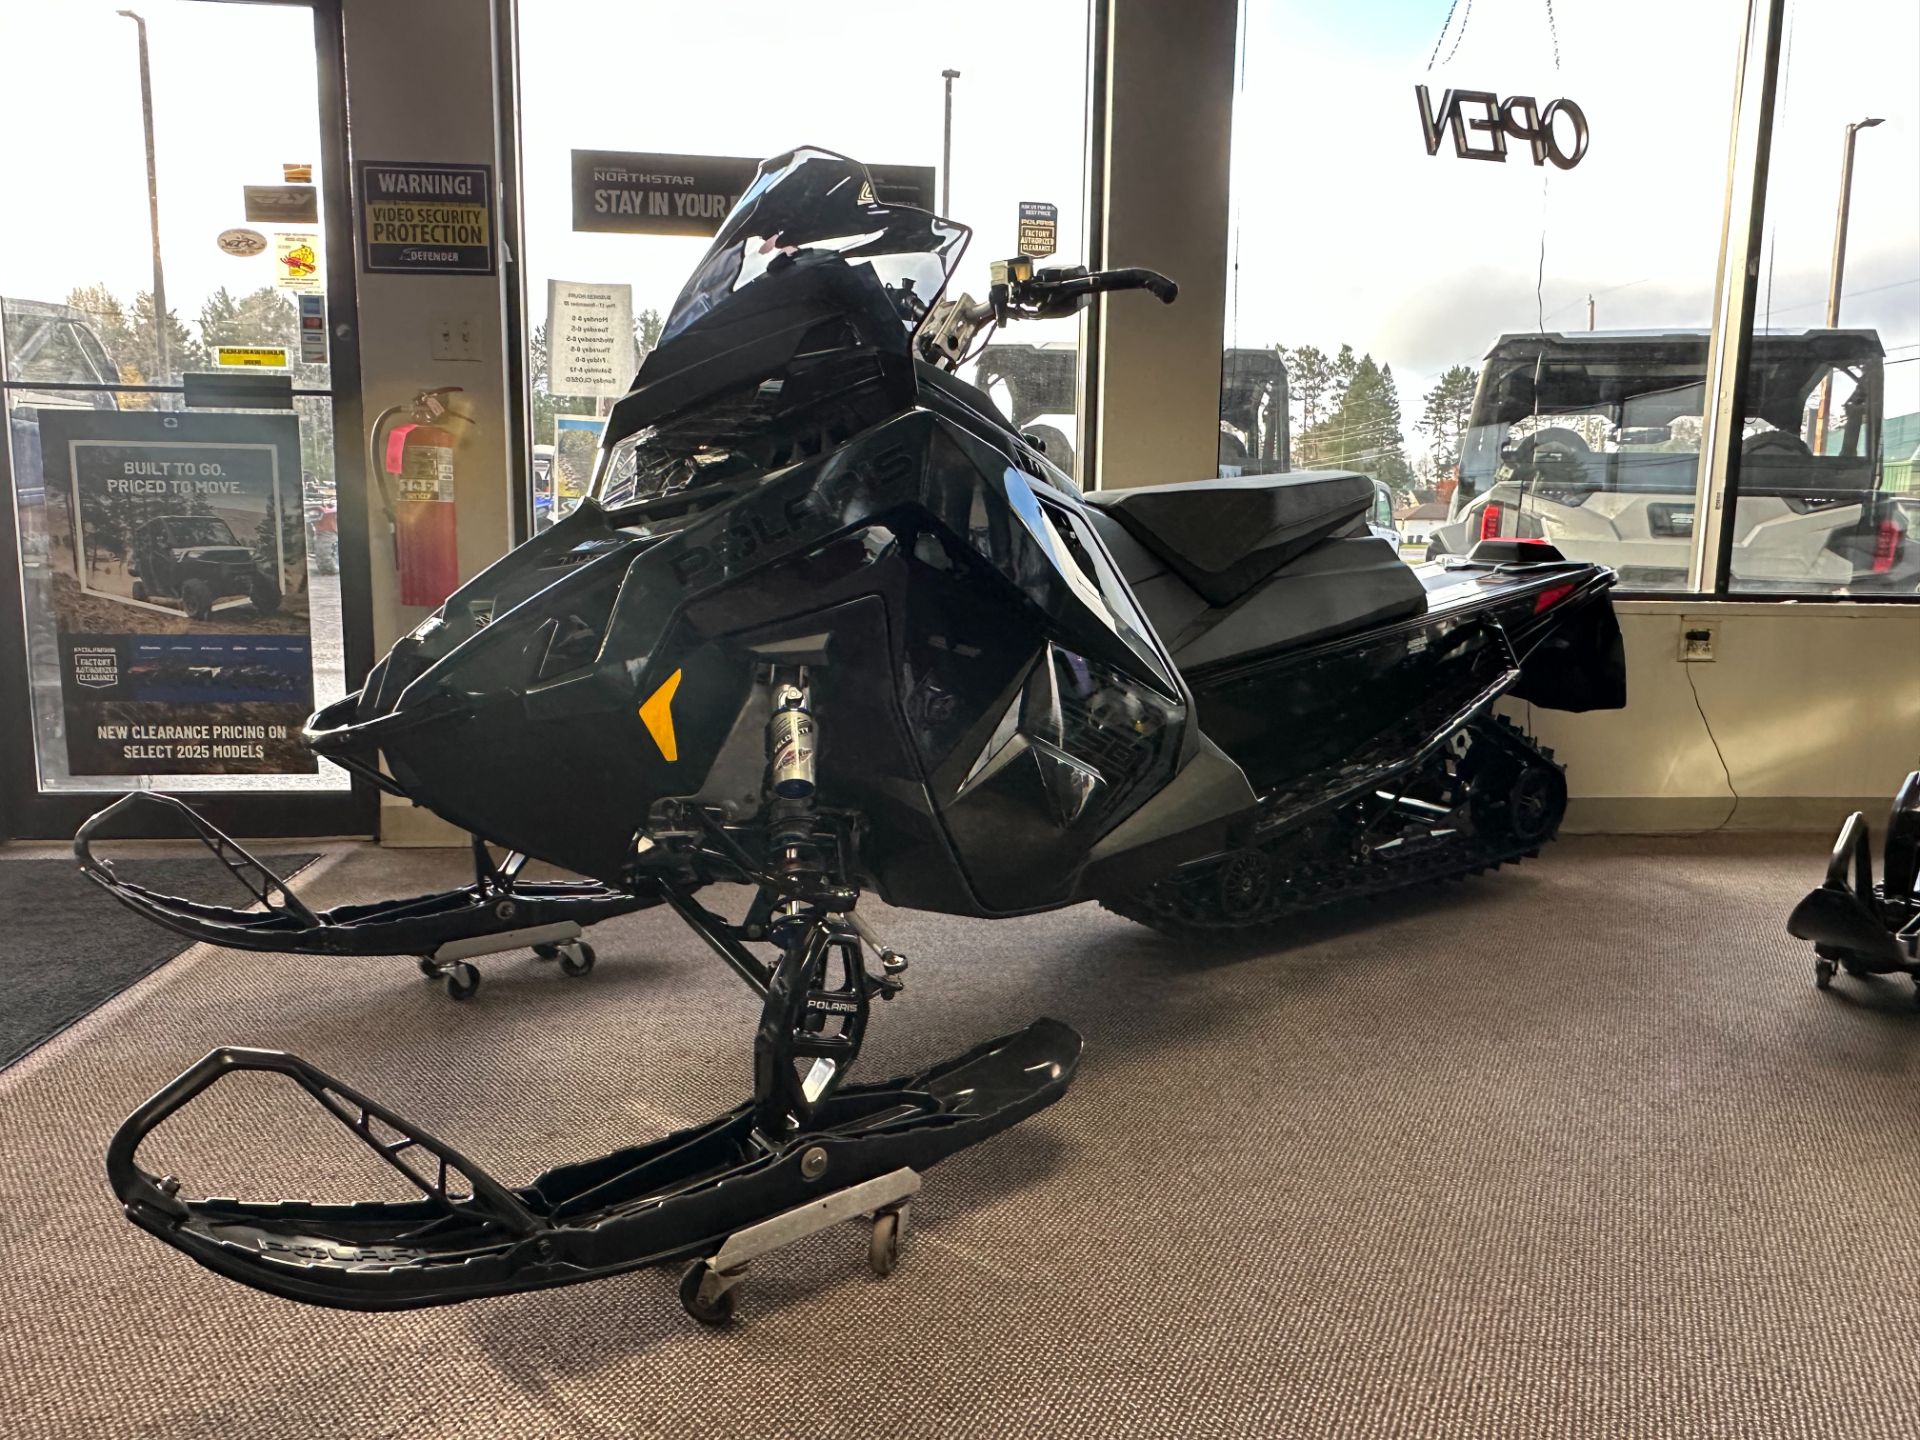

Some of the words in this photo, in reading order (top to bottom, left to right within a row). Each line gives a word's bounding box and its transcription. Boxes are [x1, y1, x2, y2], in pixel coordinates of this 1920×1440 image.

[378, 172, 472, 195] WARNING!
[594, 171, 695, 186] NORTHSTAR
[594, 189, 644, 215] STAY
[648, 191, 669, 216] IN
[673, 192, 726, 218] YOUR
[373, 207, 415, 223] VIDEO
[417, 208, 481, 224] SECURITY
[373, 223, 482, 244] PROTECTION
[1025, 230, 1050, 238] FACTORY
[1020, 237, 1054, 246] AUTHORIZED
[1022, 244, 1051, 252] CLEARANCE
[410, 250, 459, 262] DEFENDER
[124, 461, 171, 476] BUILT
[173, 462, 196, 476] TO
[199, 463, 226, 477] GO.
[106, 479, 167, 494] PRICED
[170, 480, 192, 494] TO
[195, 481, 246, 495] MOVE.
[670, 446, 913, 585] POLARS
[97, 725, 128, 740] NEW
[131, 725, 210, 740] CLEARANCE
[212, 725, 265, 740] PRICING
[268, 725, 287, 739] ON
[123, 745, 173, 759] SELECT
[176, 745, 210, 759] 2025
[212, 745, 265, 760] MODELS
[807, 1000, 858, 1012] POLARIS
[258, 1238, 425, 1262] POLARI
